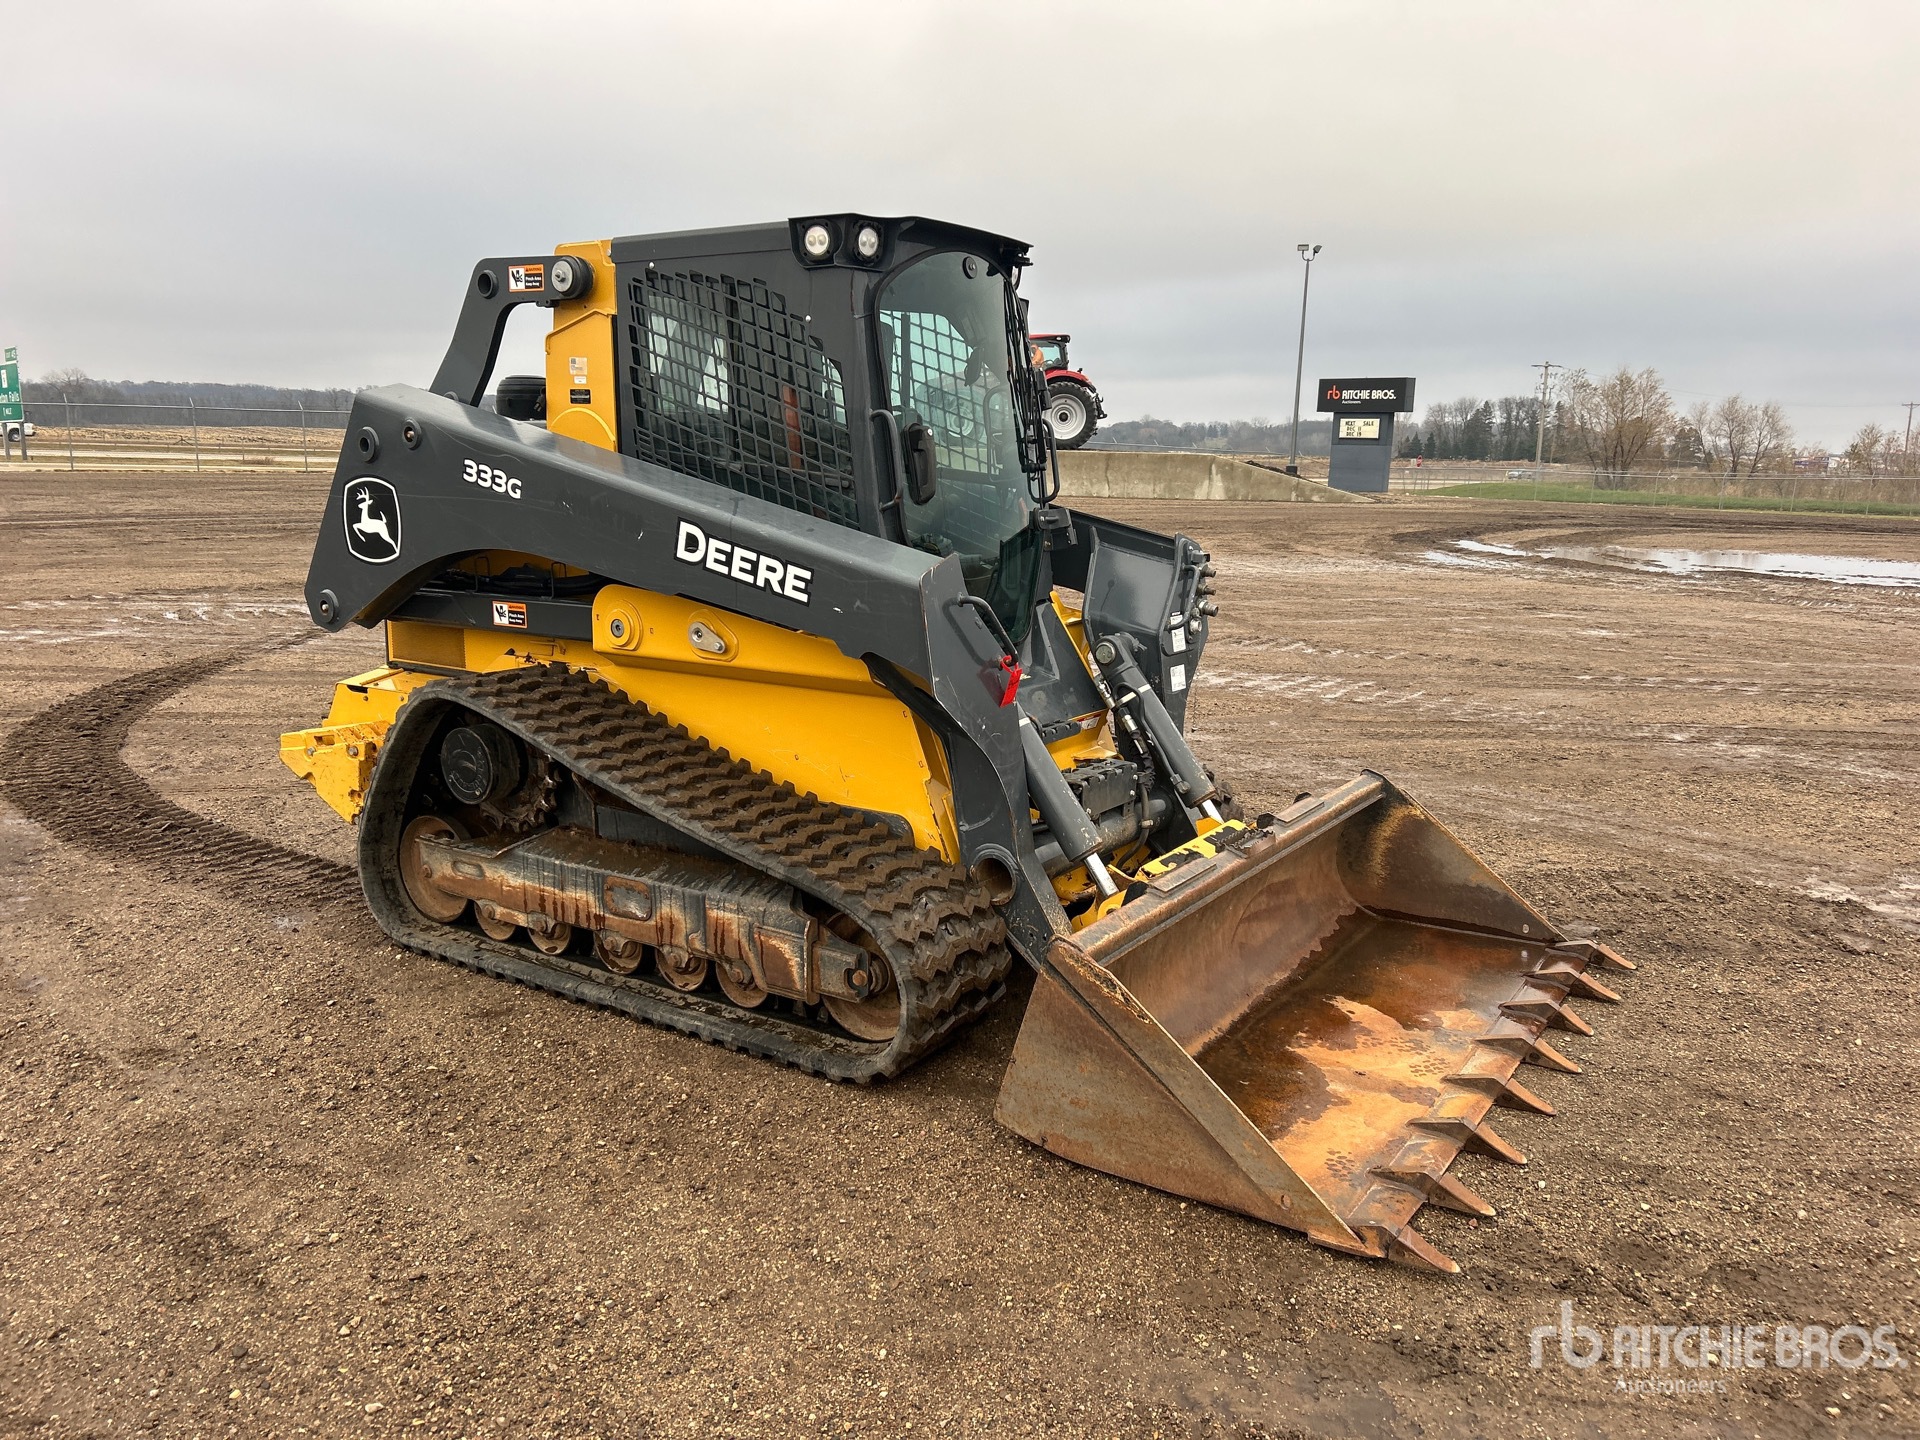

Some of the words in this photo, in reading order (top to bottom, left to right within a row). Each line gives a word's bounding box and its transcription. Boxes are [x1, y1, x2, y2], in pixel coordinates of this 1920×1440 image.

[1342, 389, 1371, 400] RITCHIE
[1371, 389, 1397, 400] BROS.
[463, 459, 522, 499] 333G
[676, 521, 812, 604] DEERE
